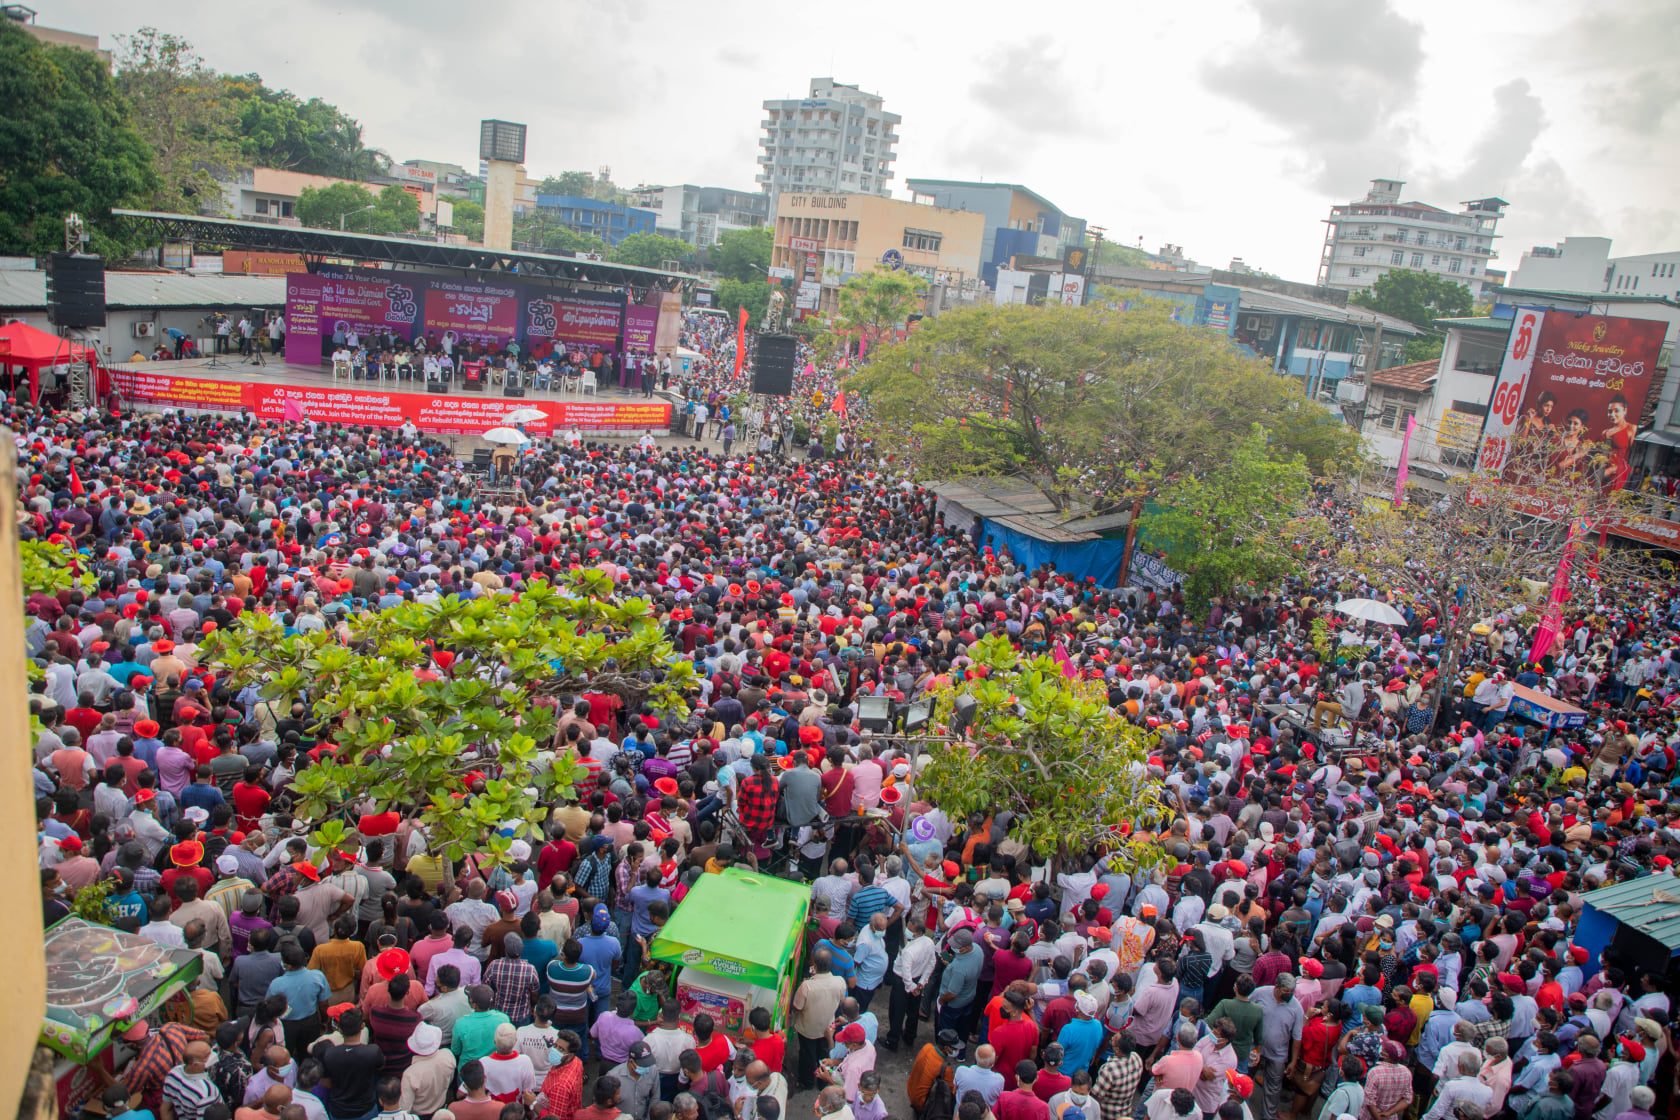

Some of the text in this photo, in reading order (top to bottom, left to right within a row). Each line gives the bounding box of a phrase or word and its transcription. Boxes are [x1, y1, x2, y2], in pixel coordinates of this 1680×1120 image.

[791, 195, 847, 209] CITY BUILDING
[795, 240, 814, 250] DSI
[332, 272, 344, 280] the
[322, 283, 334, 294] oin
[430, 281, 440, 289] 74
[1566, 341, 1625, 358] Nileka Jewellery
[328, 410, 340, 418] Join
[351, 412, 365, 420] Party
[384, 414, 402, 422] People
[432, 416, 452, 424] Rebuild
[708, 958, 747, 974] FAVOURITE
